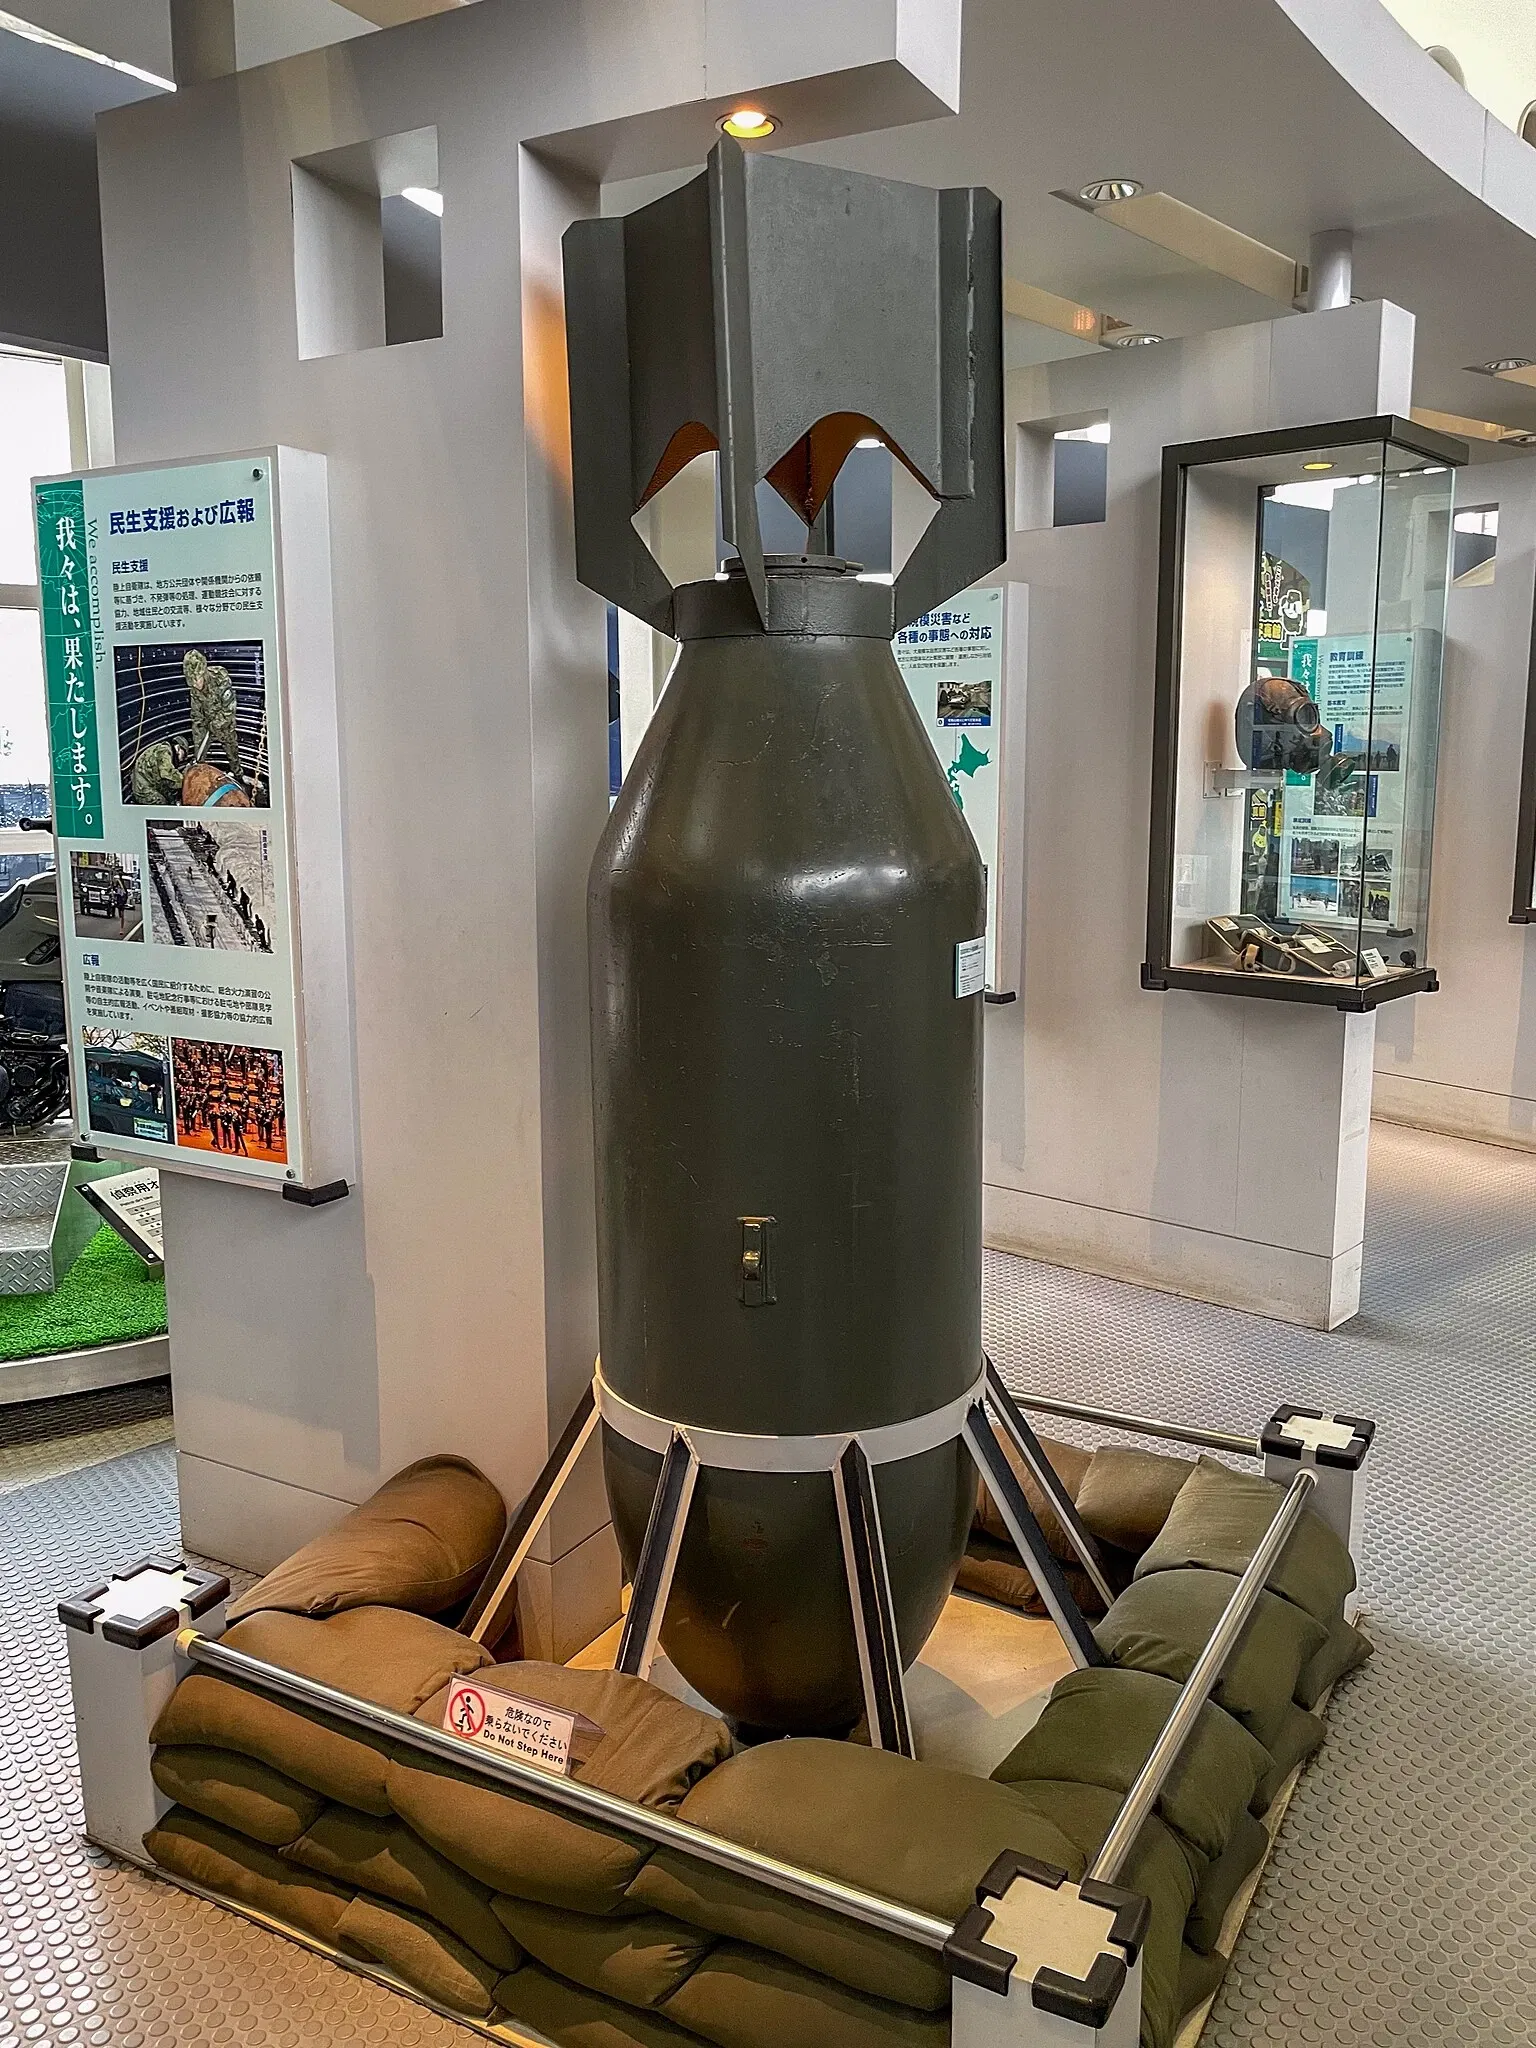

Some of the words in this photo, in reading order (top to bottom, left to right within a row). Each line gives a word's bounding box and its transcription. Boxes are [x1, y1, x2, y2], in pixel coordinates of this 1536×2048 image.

[110, 498, 255, 535] 民生支援および広報
[87, 519, 99, 549] We
[112, 559, 149, 575] 民生支援
[88, 555, 107, 670] accomplish.
[898, 626, 992, 644] 各種の事態への対応
[55, 517, 93, 826] 我々は、果たします。
[1330, 651, 1364, 662] 教育訓練
[83, 954, 100, 966] 広報
[484, 1715, 567, 1750] 乗らないでください
[505, 1706, 551, 1731] 危険なので
[483, 1729, 495, 1741] Do
[498, 1735, 514, 1748] Not
[516, 1742, 538, 1758] Step
[540, 1750, 564, 1765] Here
